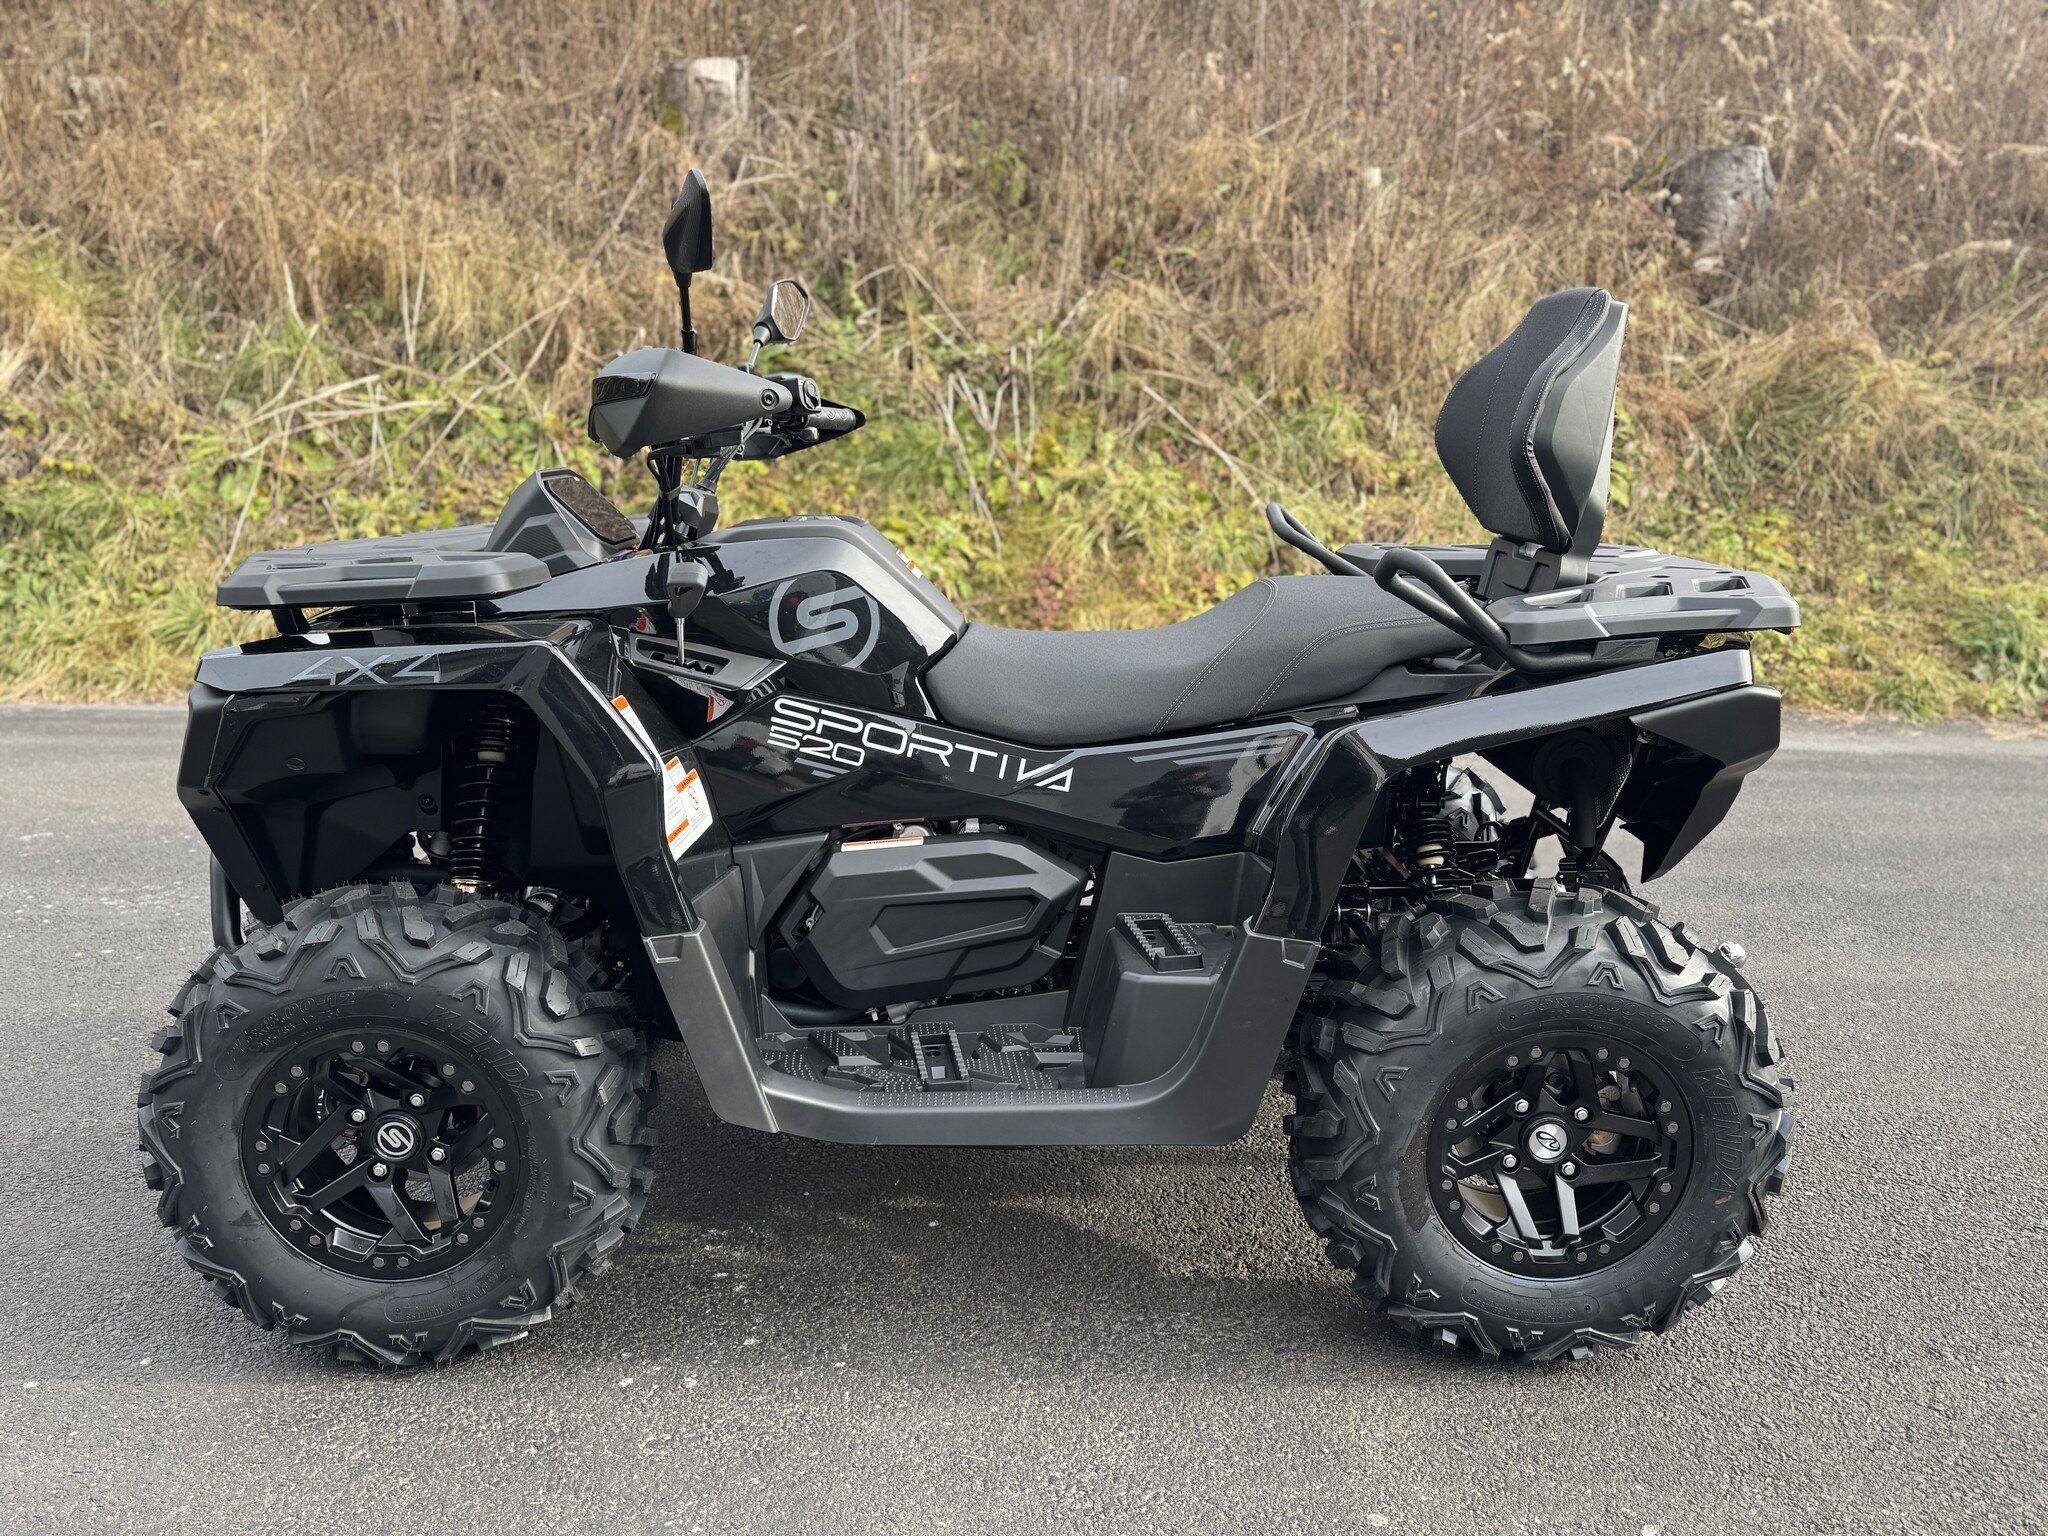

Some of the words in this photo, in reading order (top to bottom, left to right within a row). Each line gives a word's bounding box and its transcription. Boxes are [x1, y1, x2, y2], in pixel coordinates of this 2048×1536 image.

[767, 725, 866, 767] 520
[770, 698, 1074, 793] SPORTIVA
[420, 1004, 544, 1108] KENDA
[1691, 1067, 1744, 1194] KENDA
